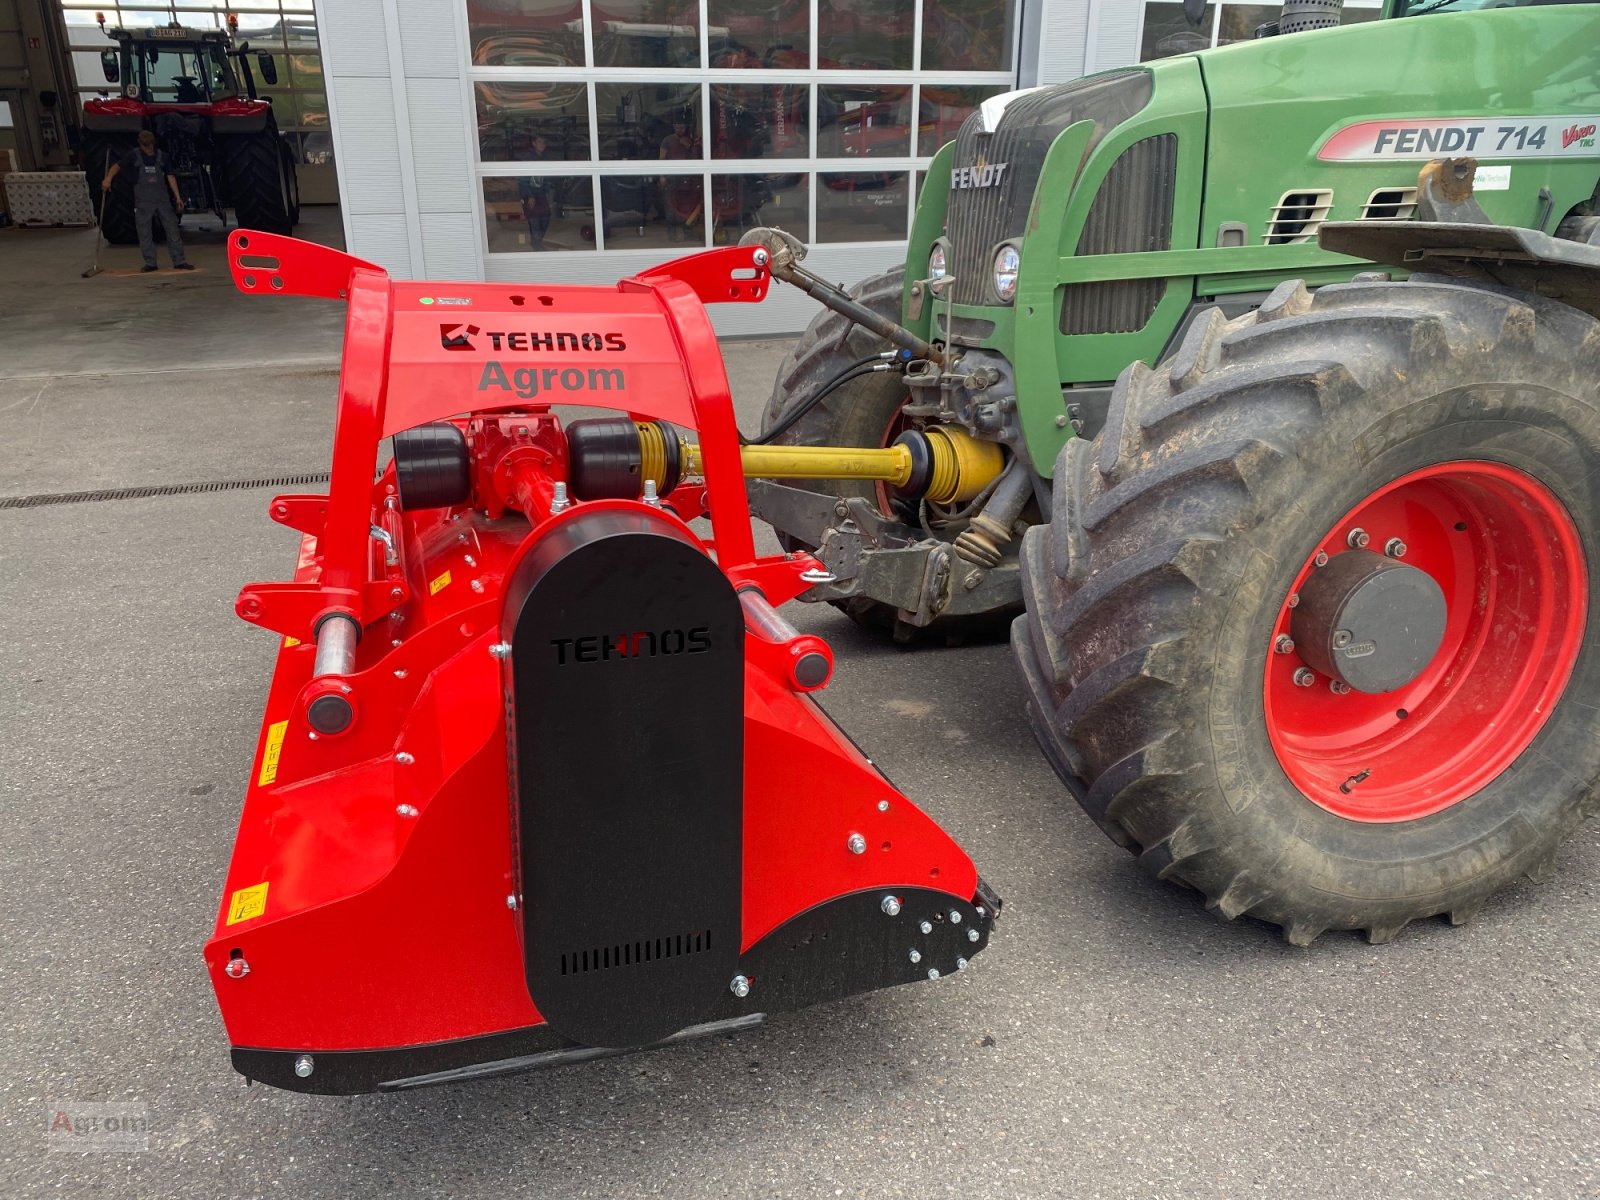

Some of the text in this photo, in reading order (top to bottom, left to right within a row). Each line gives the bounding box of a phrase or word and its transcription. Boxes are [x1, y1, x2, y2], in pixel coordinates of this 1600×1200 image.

[128, 86, 137, 96] 50
[1373, 125, 1548, 154] FENDT 714
[1579, 138, 1596, 147] TMS
[951, 162, 1008, 190] FENDT
[486, 332, 627, 352] TEHNOS
[477, 360, 625, 399] Agrom
[550, 626, 712, 665] TEHNOS
